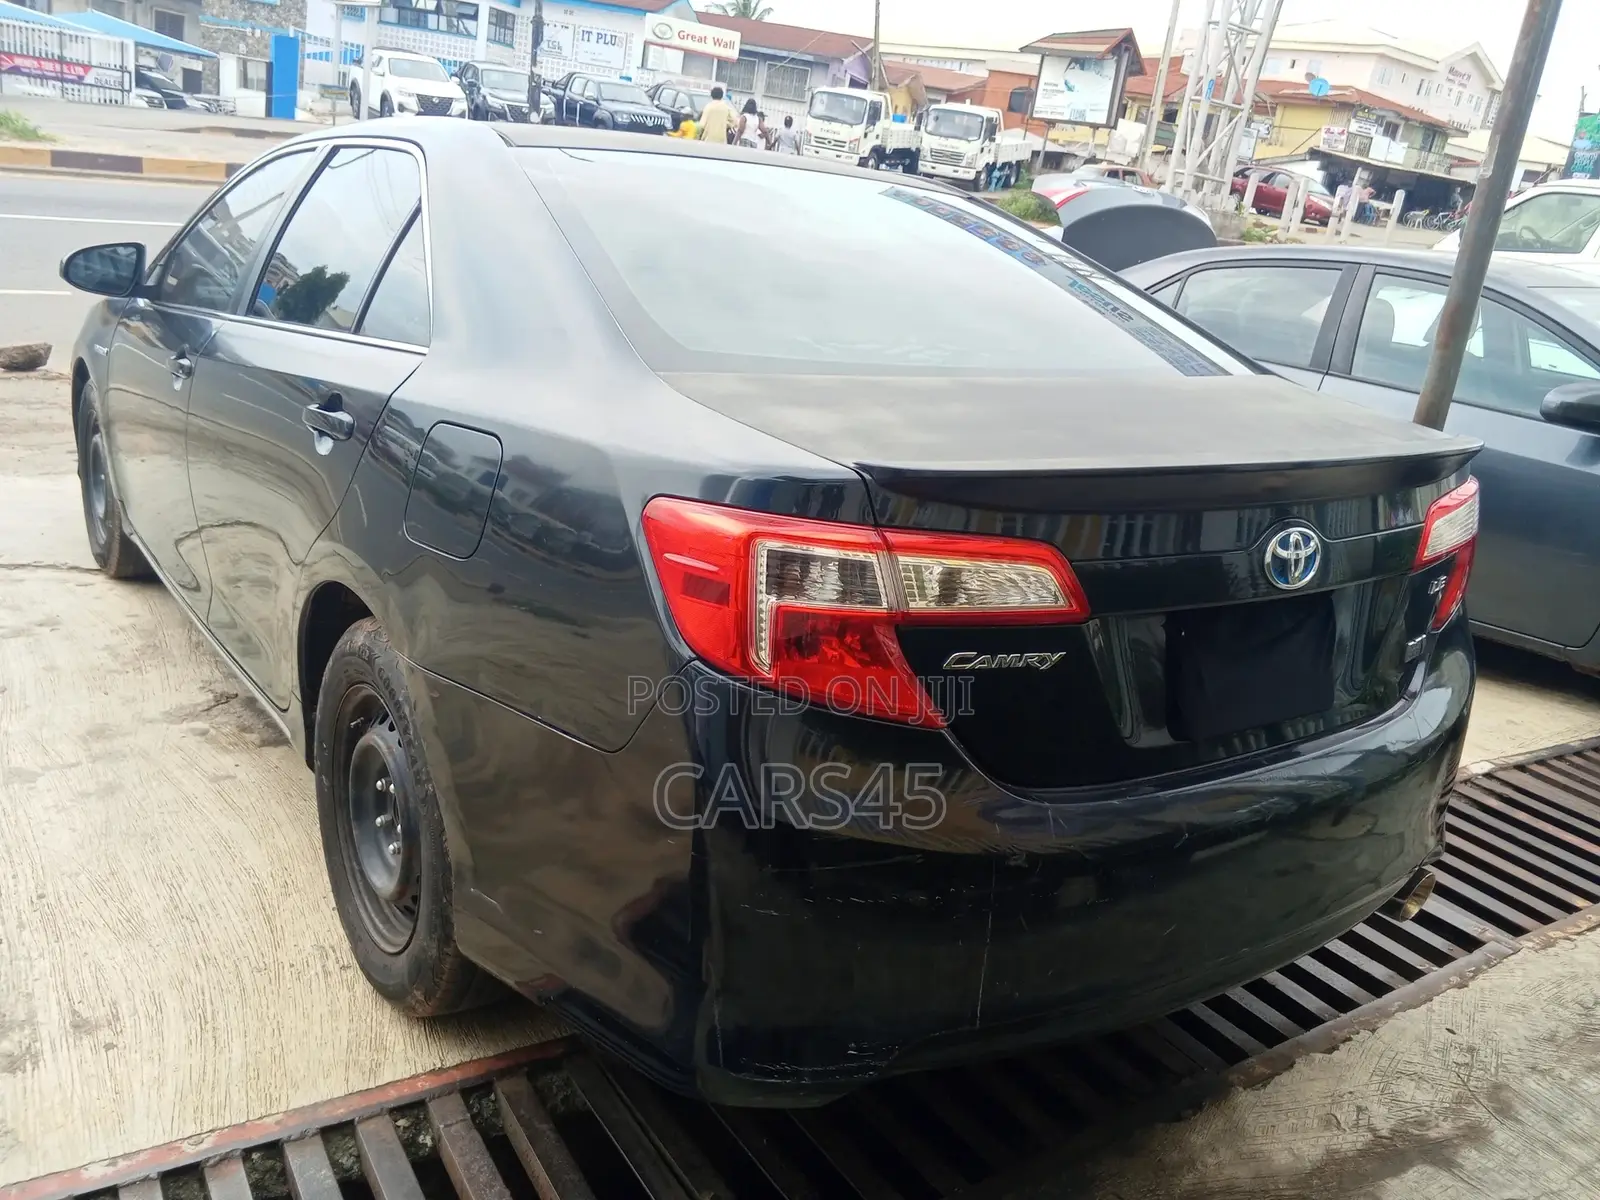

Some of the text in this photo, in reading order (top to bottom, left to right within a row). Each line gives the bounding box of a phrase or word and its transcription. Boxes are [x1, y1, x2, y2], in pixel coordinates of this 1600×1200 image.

[581, 29, 593, 43] IT
[677, 29, 736, 50] Great Wall
[942, 651, 1067, 670] CAMRY
